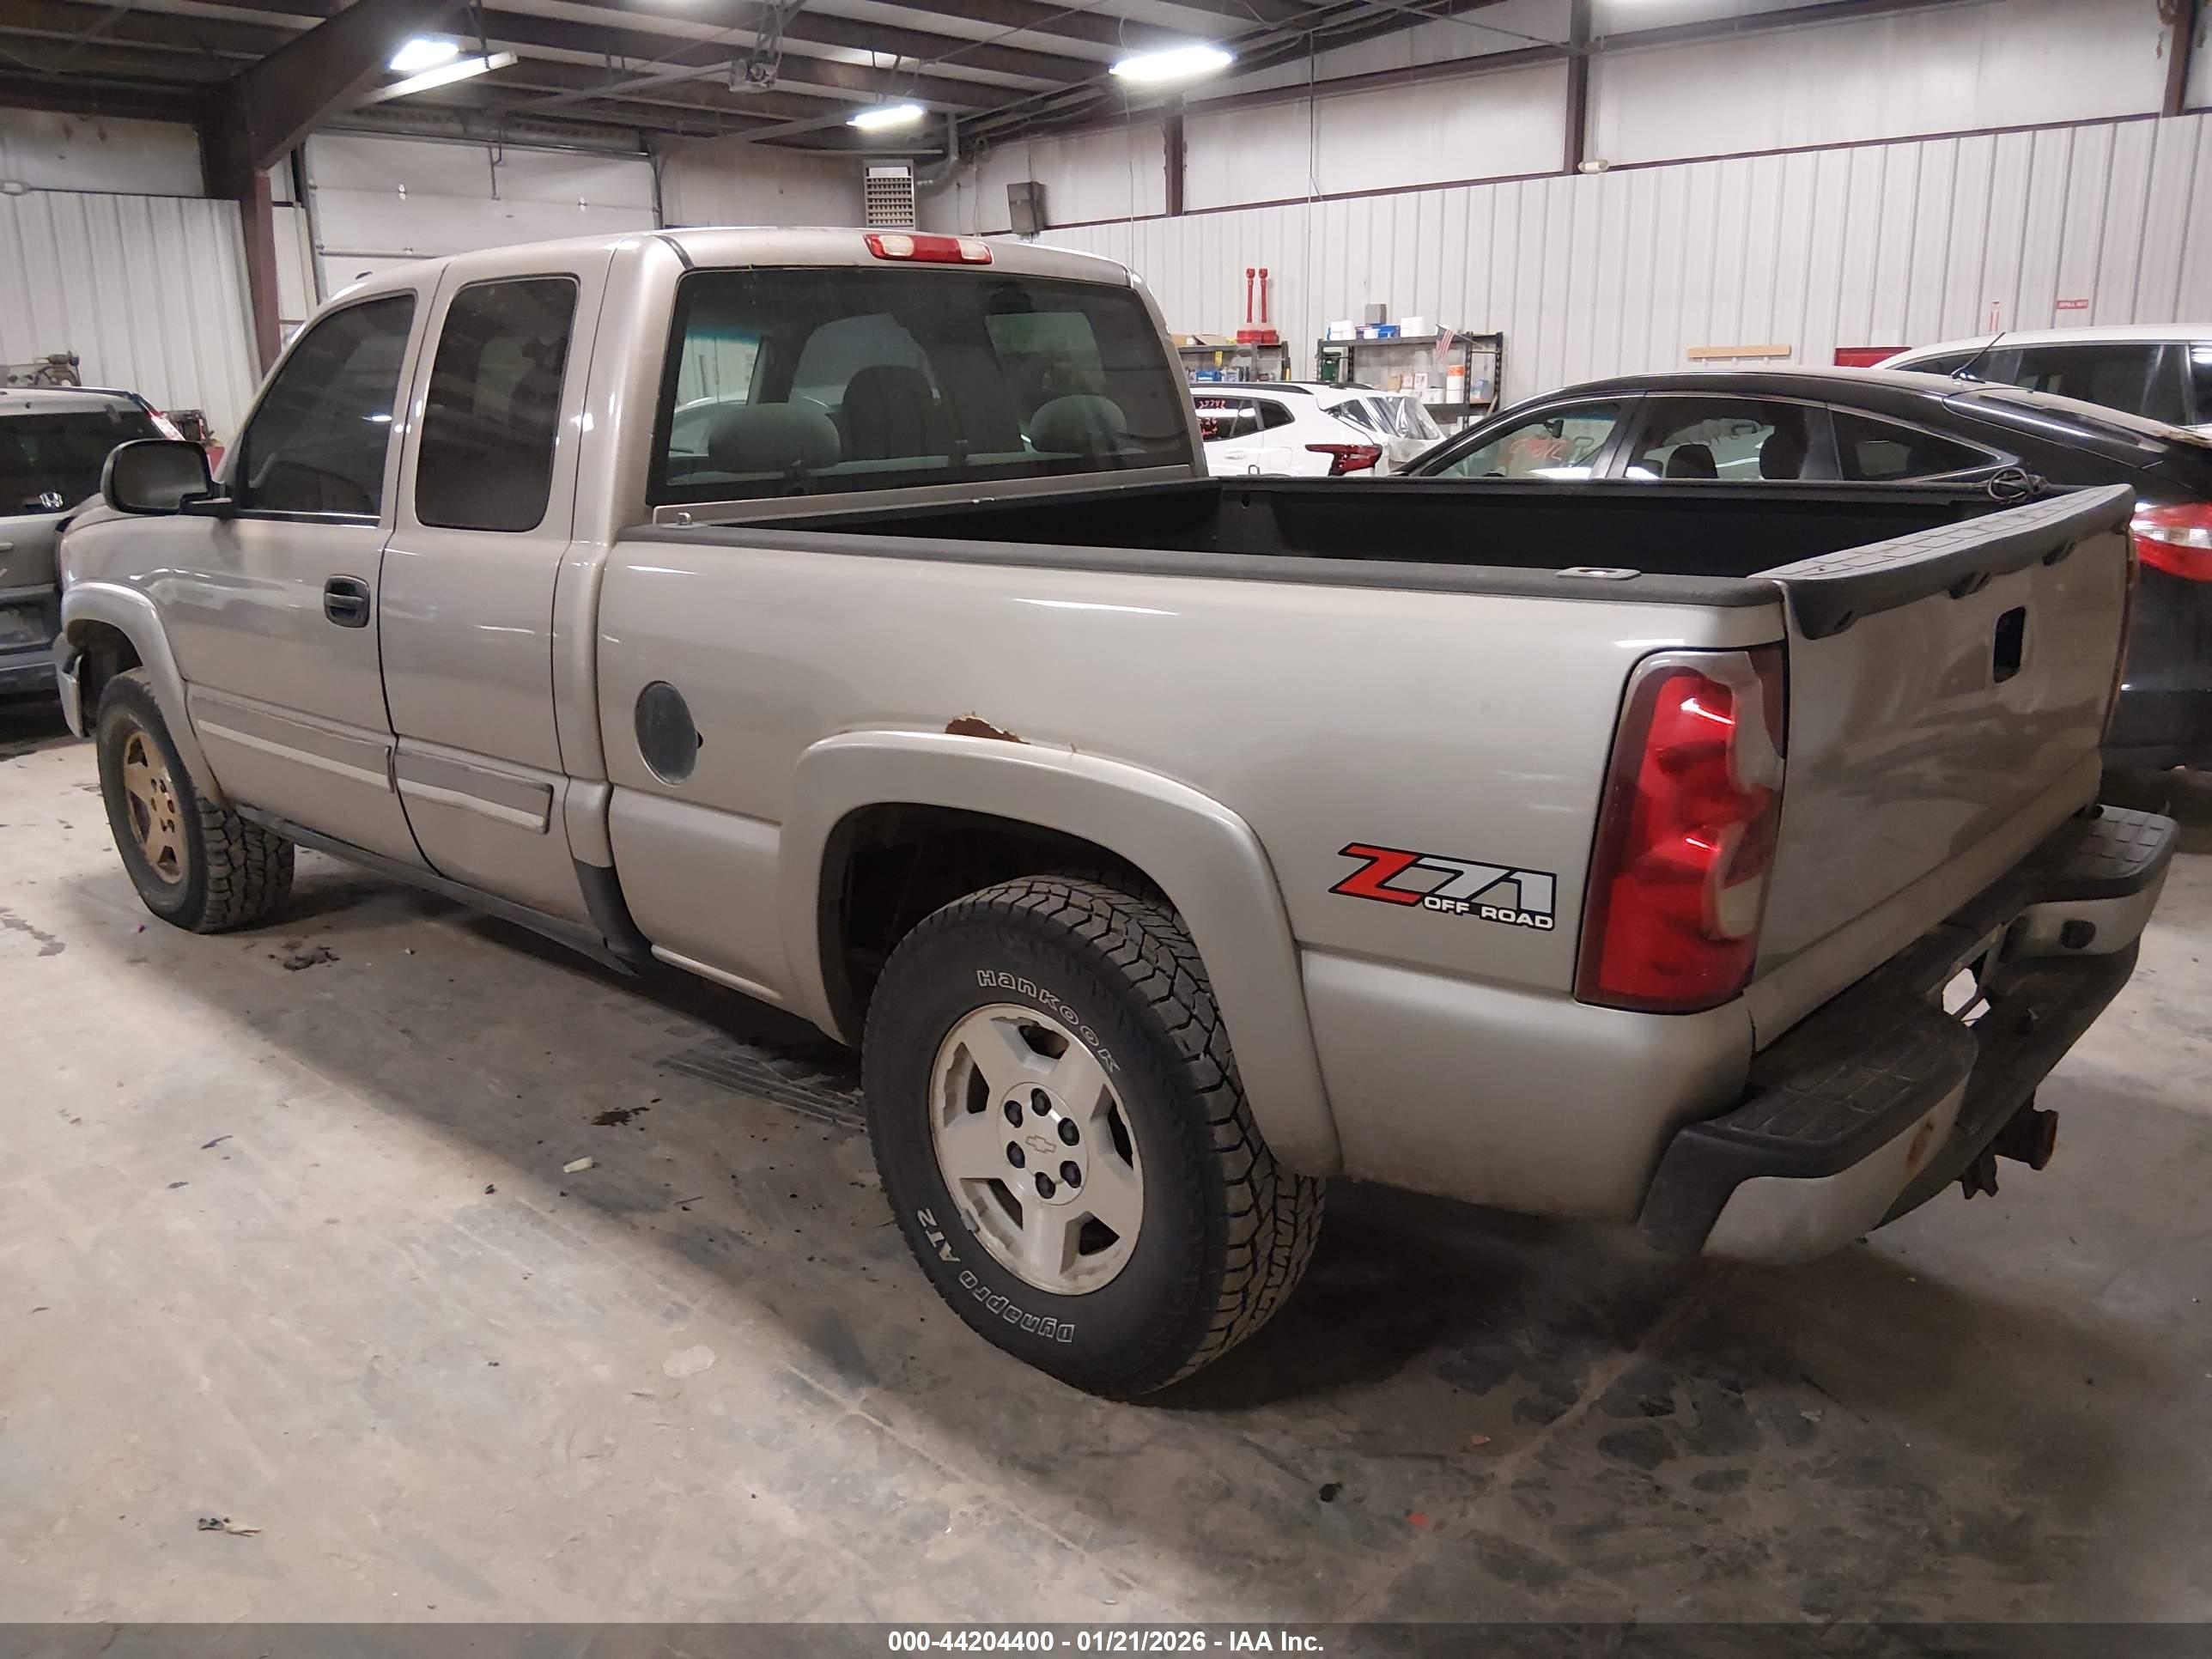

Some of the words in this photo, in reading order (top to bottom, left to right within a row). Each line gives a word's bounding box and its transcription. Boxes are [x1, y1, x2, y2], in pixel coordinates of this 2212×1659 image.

[1328, 842, 1557, 914] Z71
[1423, 896, 1470, 915] OFF
[1480, 906, 1553, 929] ROAD
[917, 1208, 961, 1261] AT2
[958, 1270, 1075, 1343] Dynapro
